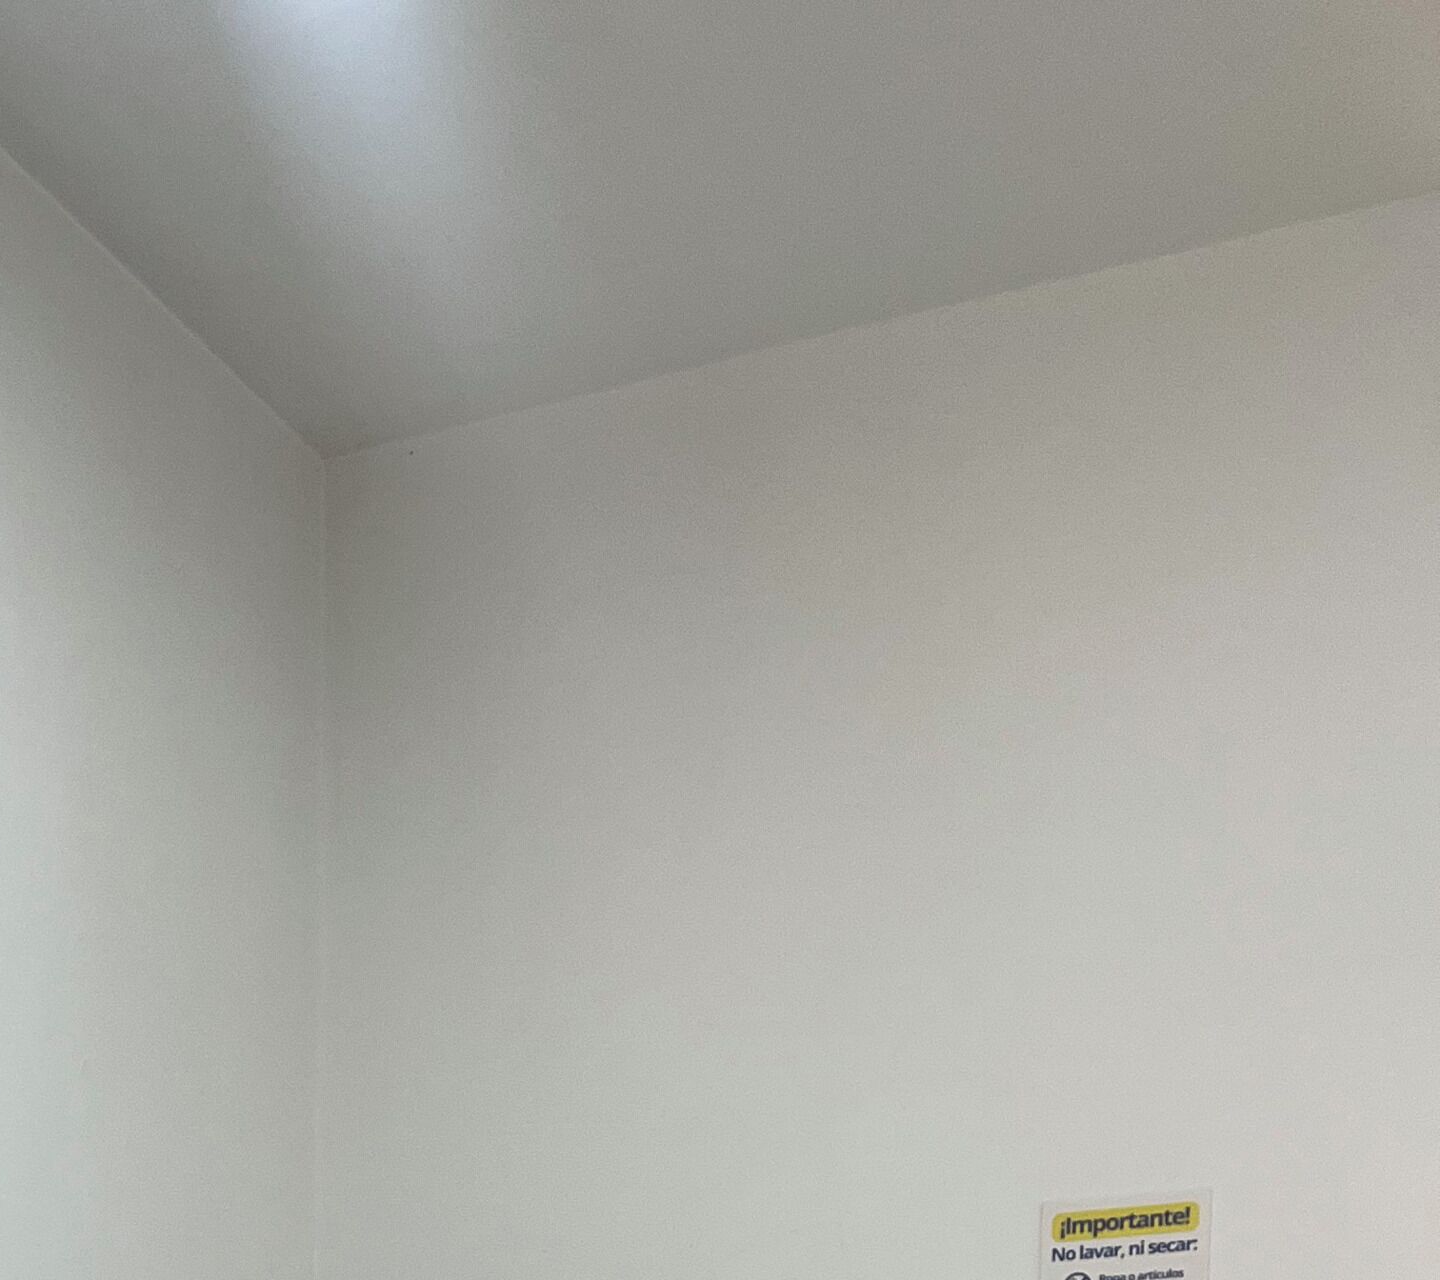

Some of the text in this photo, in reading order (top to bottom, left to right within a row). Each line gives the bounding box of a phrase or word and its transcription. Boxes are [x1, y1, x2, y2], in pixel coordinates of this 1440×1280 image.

[1060, 1206, 1190, 1239] ¡Importante!
[1051, 1239, 1198, 1262] No lavar, ni secar:
